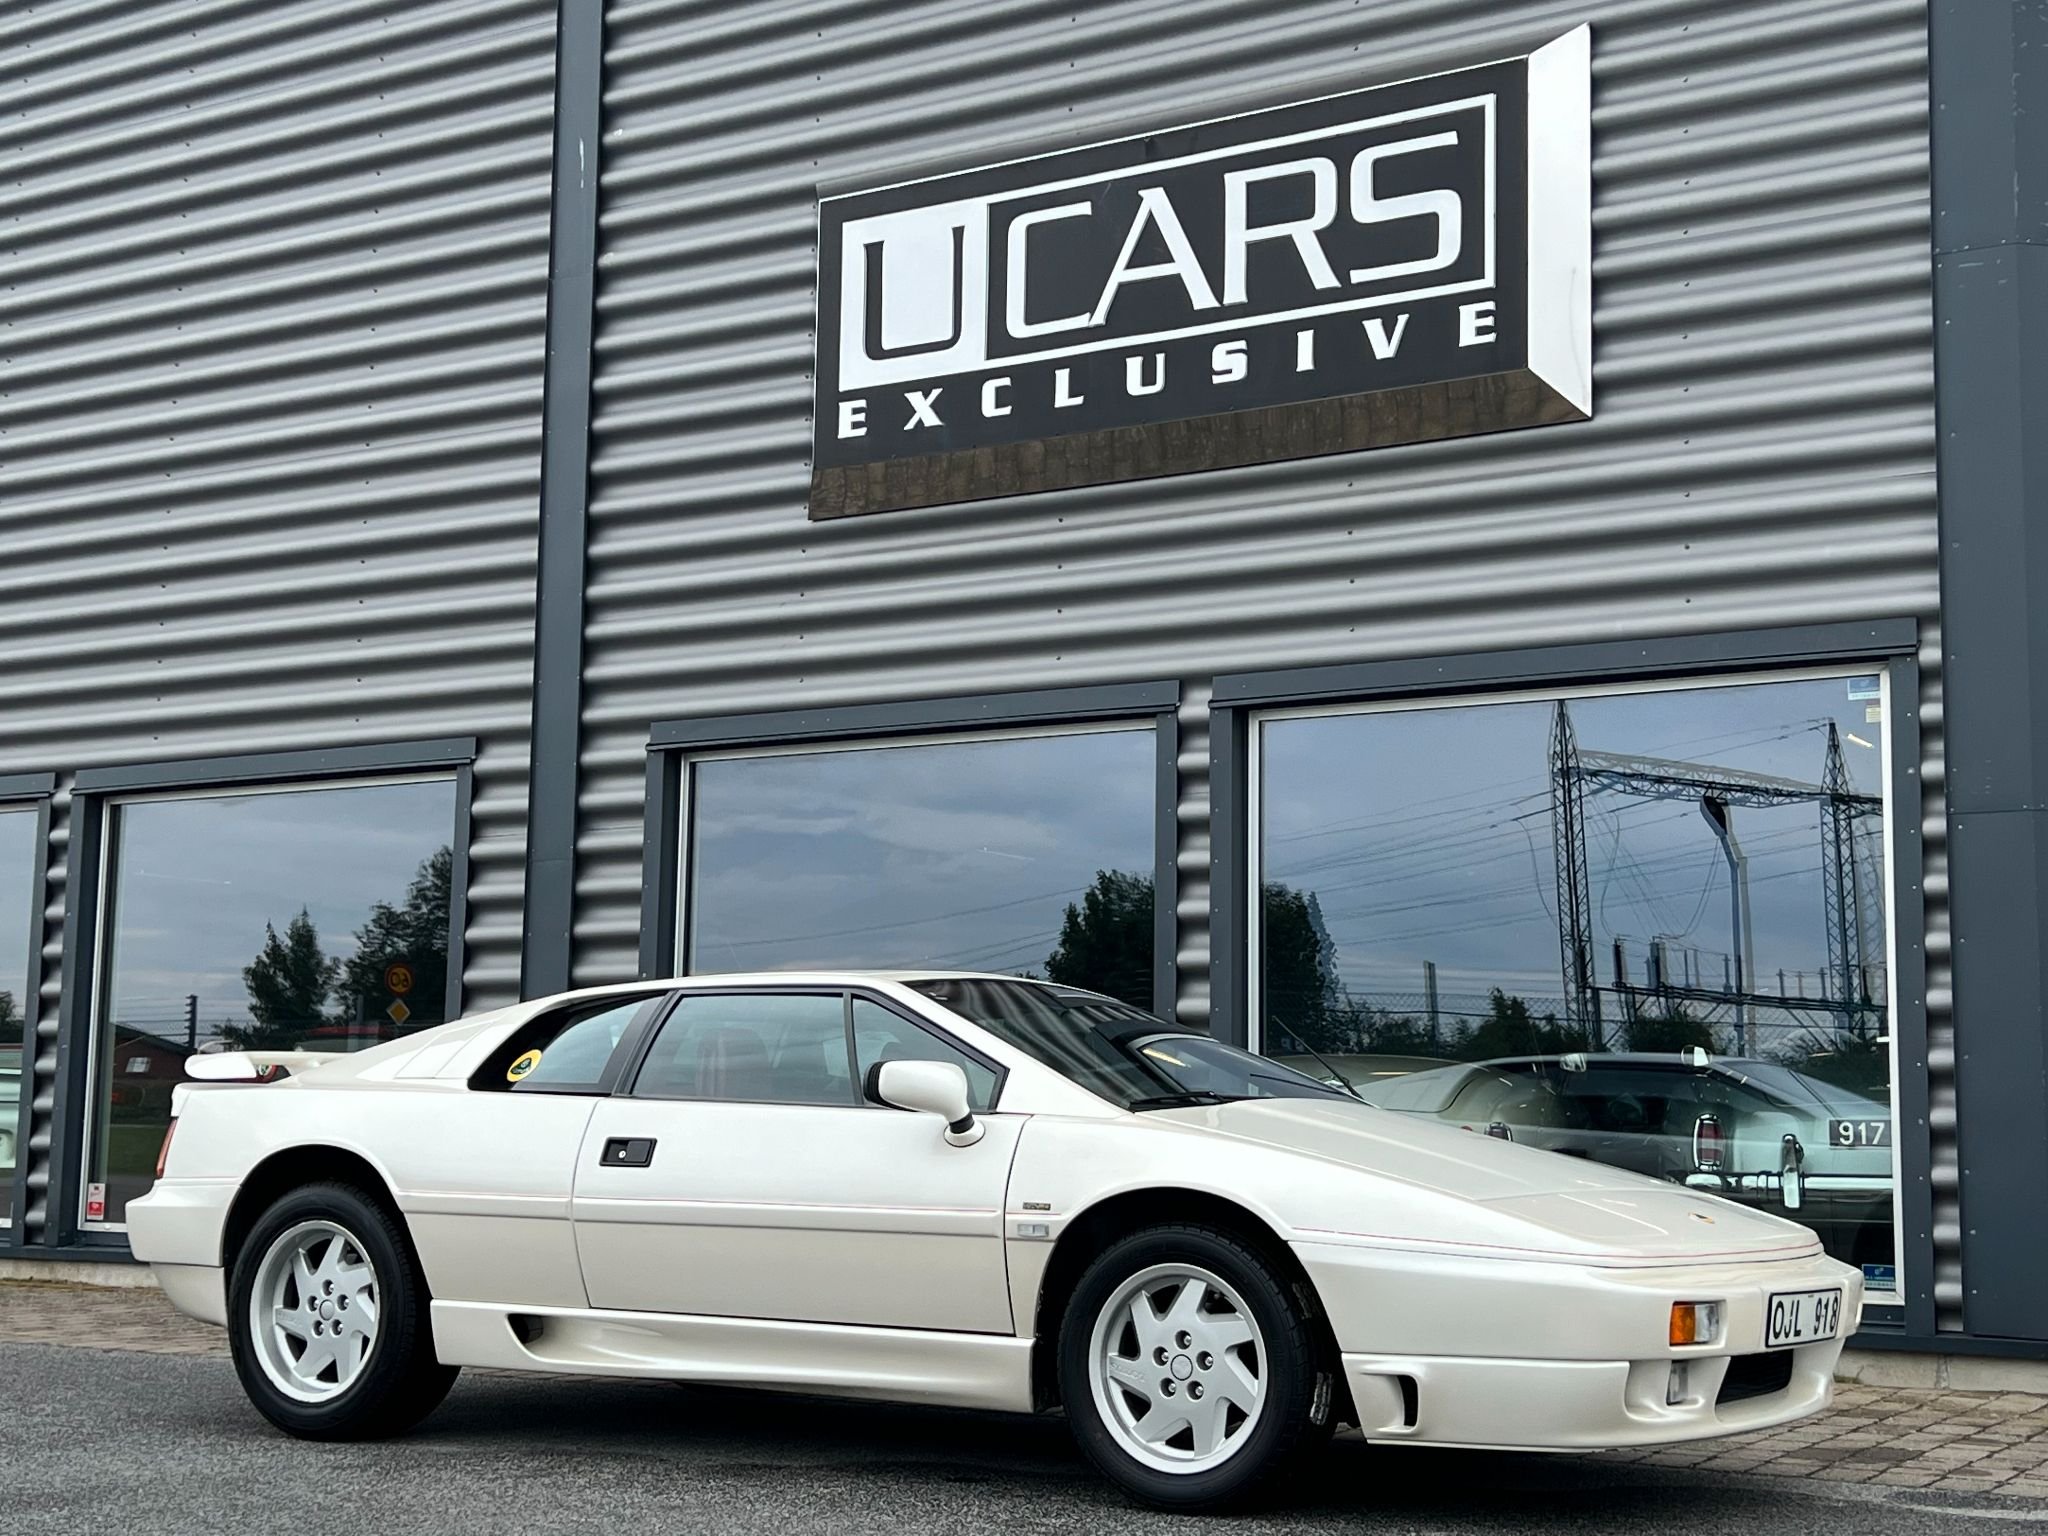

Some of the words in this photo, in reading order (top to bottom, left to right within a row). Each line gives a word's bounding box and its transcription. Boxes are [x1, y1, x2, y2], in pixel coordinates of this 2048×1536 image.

[837, 299, 1497, 440] EXCLUSIVE
[1838, 1121, 1886, 1145] 917
[1773, 1299, 1802, 1340] OJL
[1813, 1295, 1839, 1336] 918
